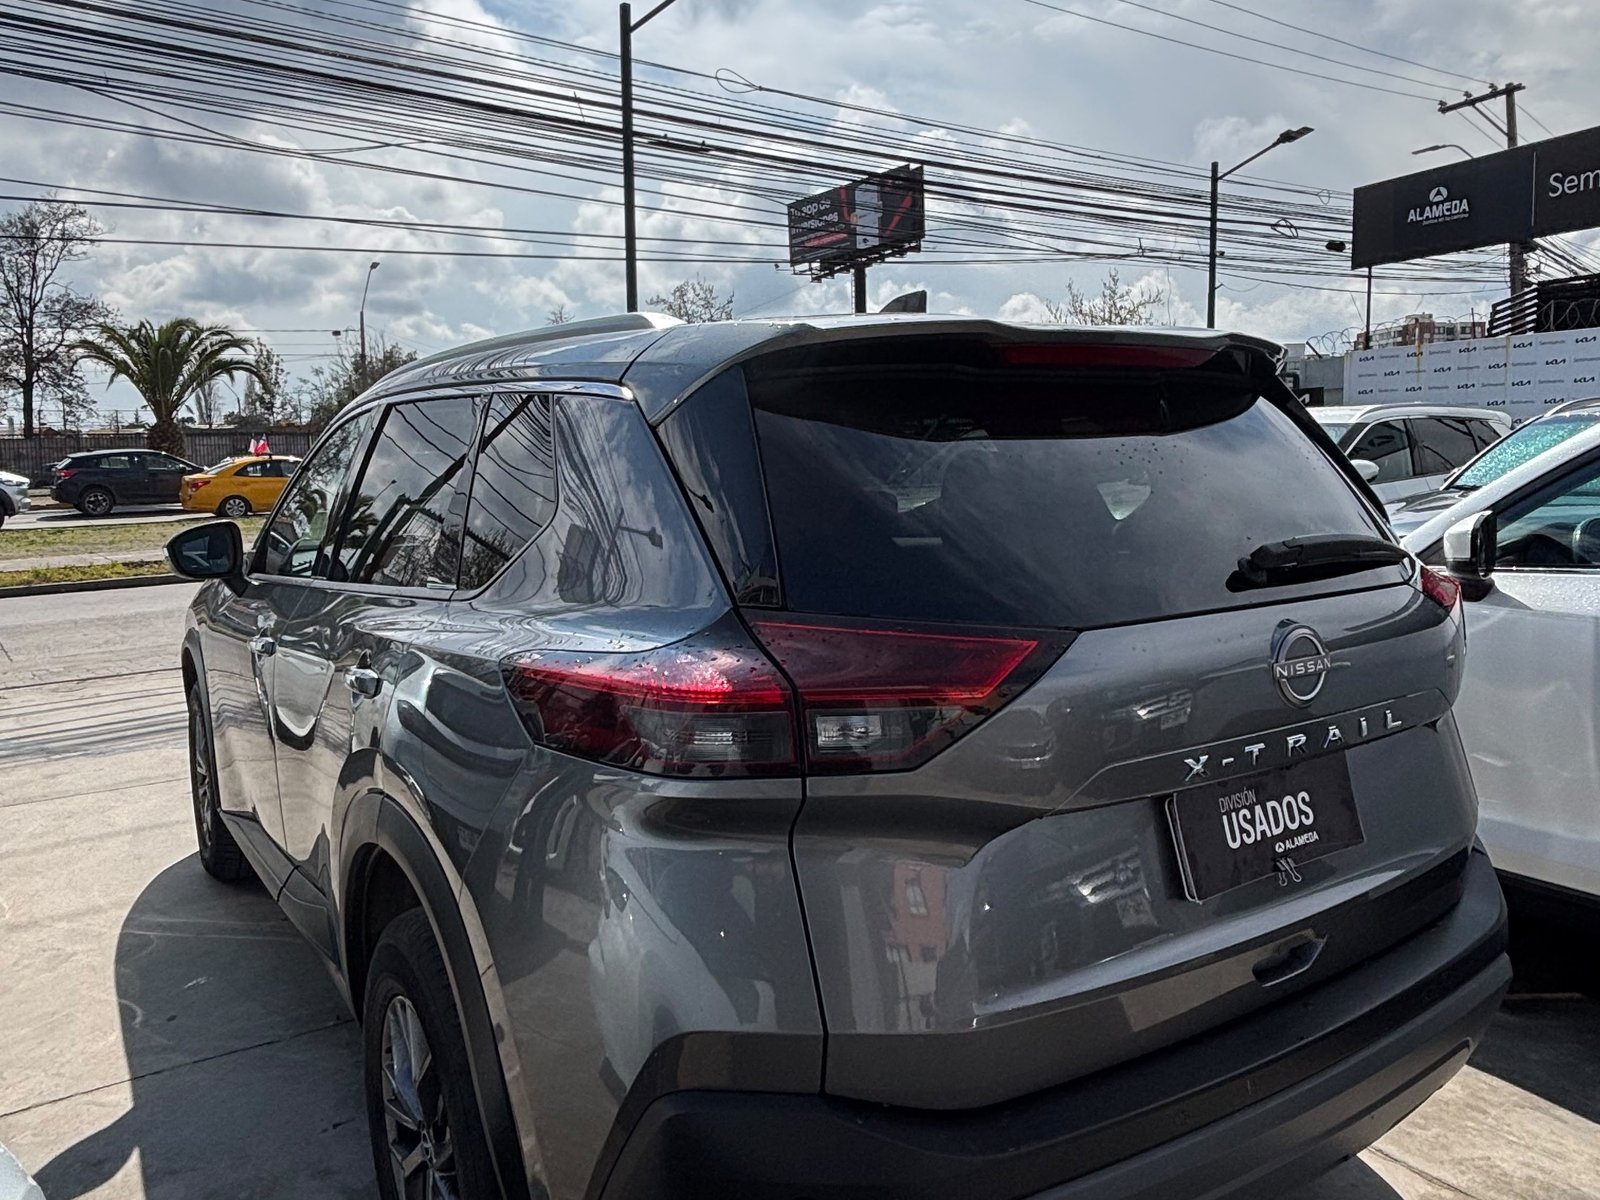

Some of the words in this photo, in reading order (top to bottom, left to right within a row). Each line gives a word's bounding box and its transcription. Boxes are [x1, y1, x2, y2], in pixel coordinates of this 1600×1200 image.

[1549, 169, 1600, 197] Sem
[1408, 198, 1469, 222] ALAMEDA
[1276, 656, 1331, 678] NISSAN
[1184, 710, 1402, 781] X-TRAIL
[1219, 787, 1257, 813] DIVISIÓN
[1222, 791, 1314, 849] USADOS
[1285, 831, 1320, 851] ALAMEDA
